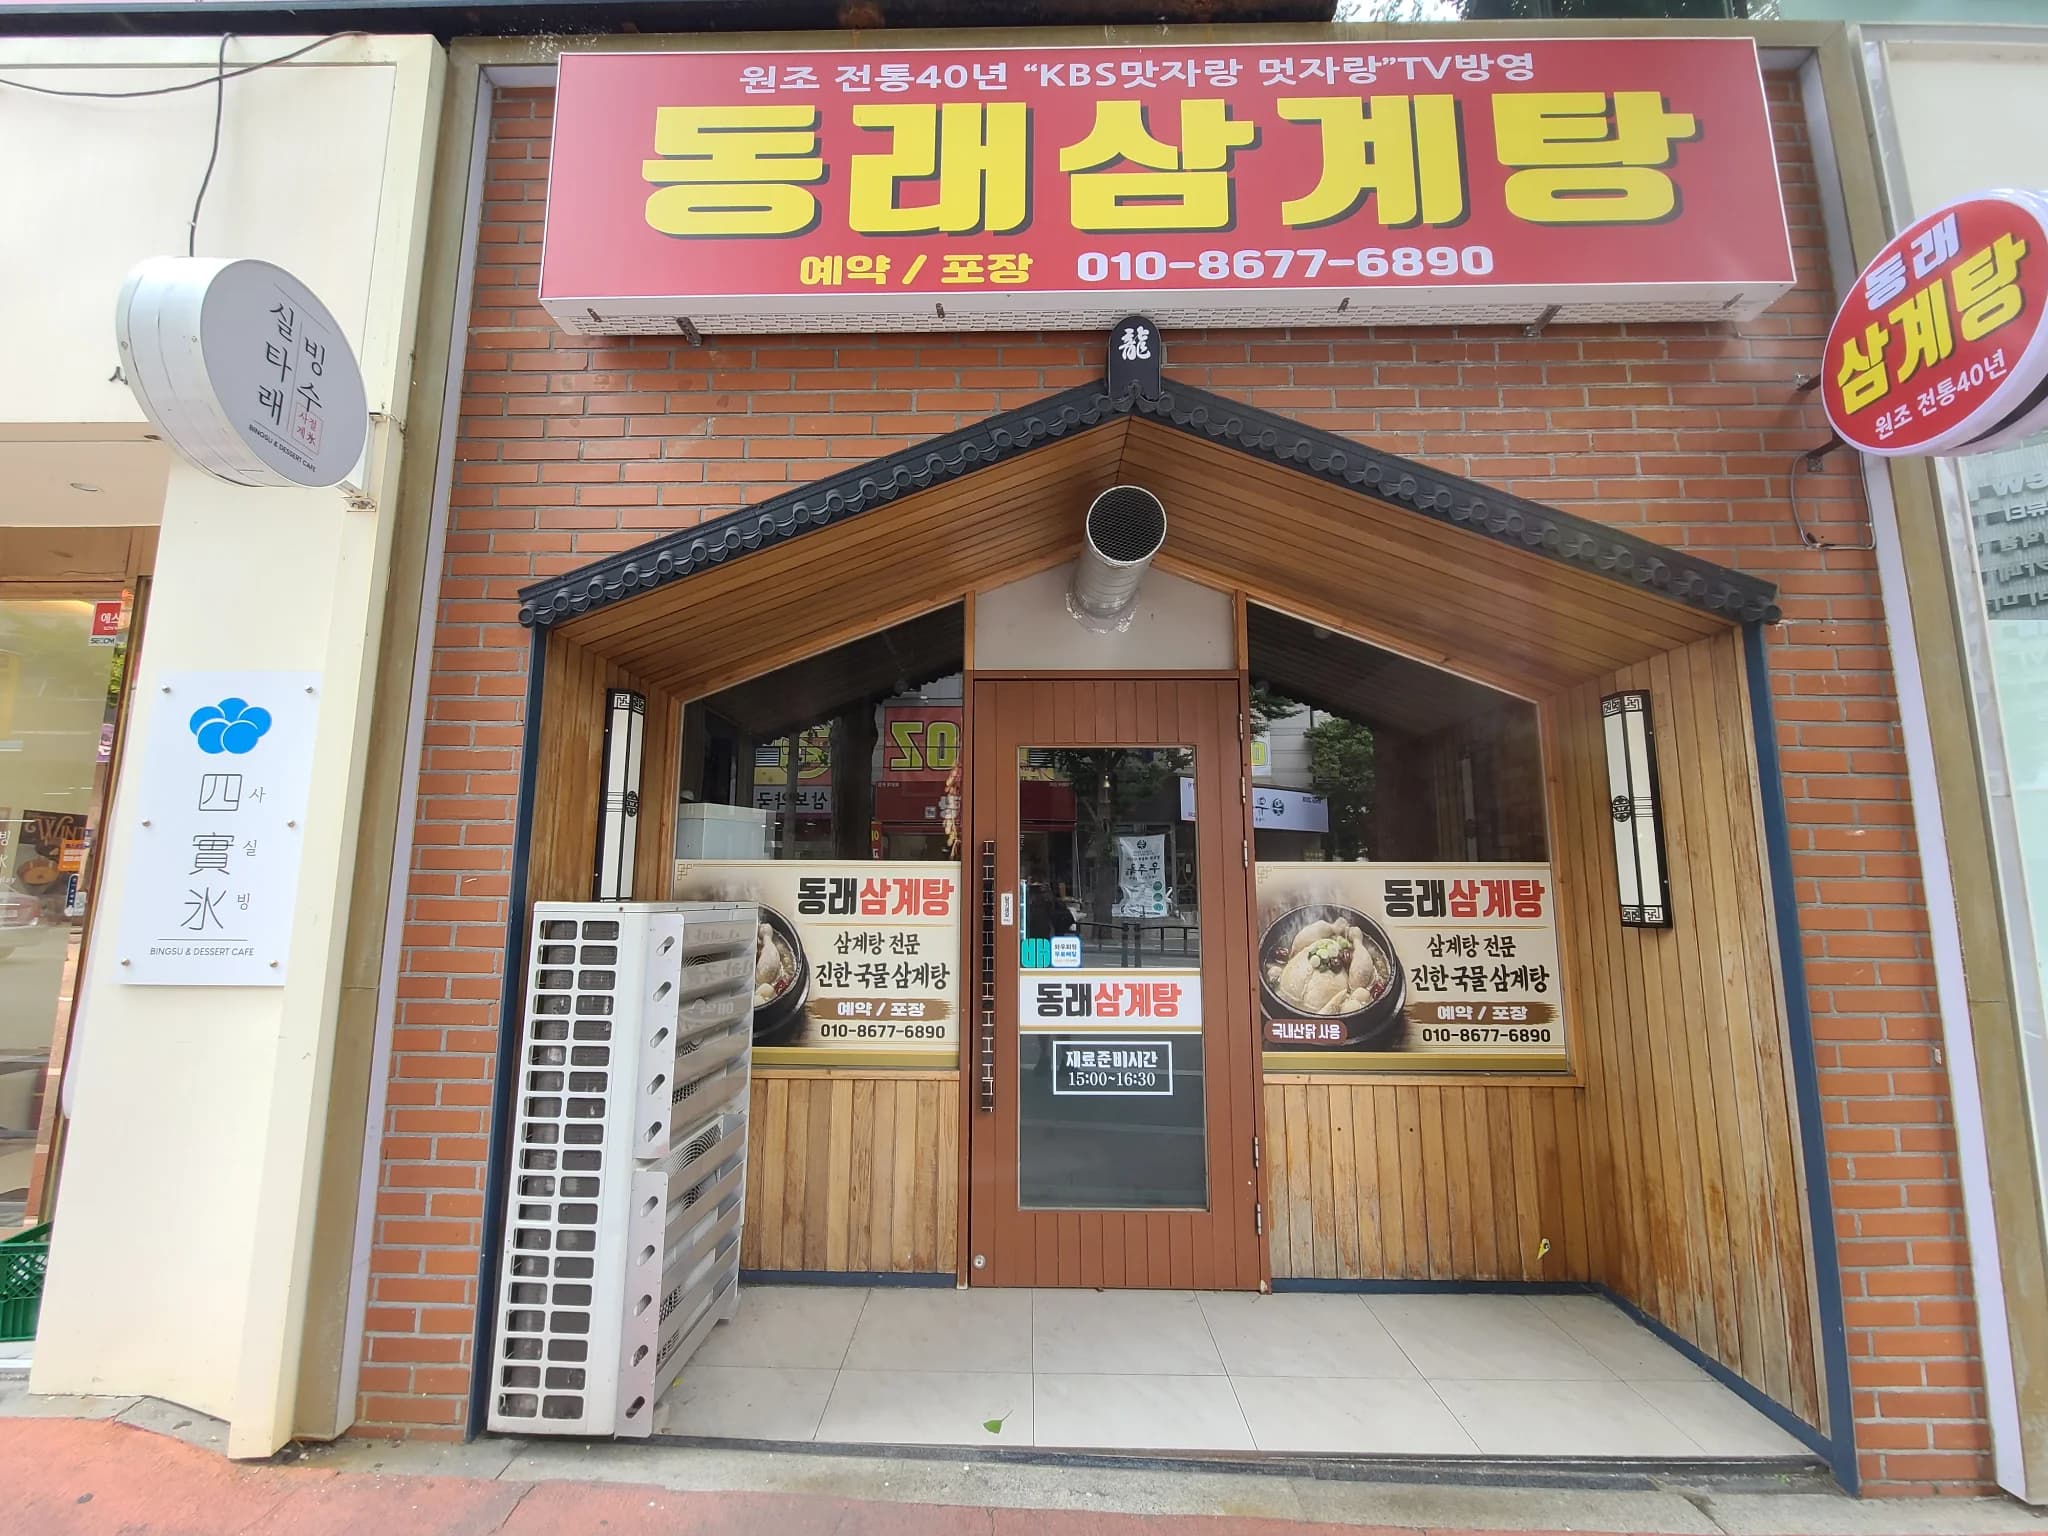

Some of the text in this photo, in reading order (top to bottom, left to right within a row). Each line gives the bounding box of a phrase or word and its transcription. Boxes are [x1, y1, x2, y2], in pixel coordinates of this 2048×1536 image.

[739, 65, 821, 94] 원조
[835, 62, 1008, 93] 전통40년
[1024, 57, 1243, 89] “KBS맛자랑
[641, 91, 1700, 238] 동래삼계탕
[799, 253, 893, 286] 예약
[940, 251, 1034, 285] 포장
[1077, 246, 1495, 283] 010-8677-6890
[1864, 212, 1962, 312] 동래
[1837, 232, 2027, 416] 삼계탕
[1118, 326, 1151, 361] 龍
[258, 303, 294, 426] 실타래
[297, 336, 326, 413] 빙수
[1875, 348, 2007, 441] 원조 전통40년
[797, 877, 955, 917] 동래삼계탕
[1383, 879, 1546, 919] 동래삼계탕
[150, 947, 255, 957] BINGSU & DESSERT CAFE
[833, 931, 921, 956] 삼계탕 전문
[1427, 933, 1517, 958] 삼계탕 전문
[837, 1001, 873, 1018] 예약
[890, 1001, 926, 1018] 포장
[1036, 983, 1182, 1018] 동래삼계탕
[1436, 1005, 1474, 1021] 예약
[1492, 1005, 1529, 1021] 포장
[820, 1023, 946, 1040] 010-8677-6890
[1271, 1023, 1341, 1040] 국내산닭 사용
[1422, 1028, 1551, 1044] 010-8677-6890
[1065, 1050, 1159, 1069] 재료준비시간
[1068, 1071, 1156, 1088] 15:00~16:30
